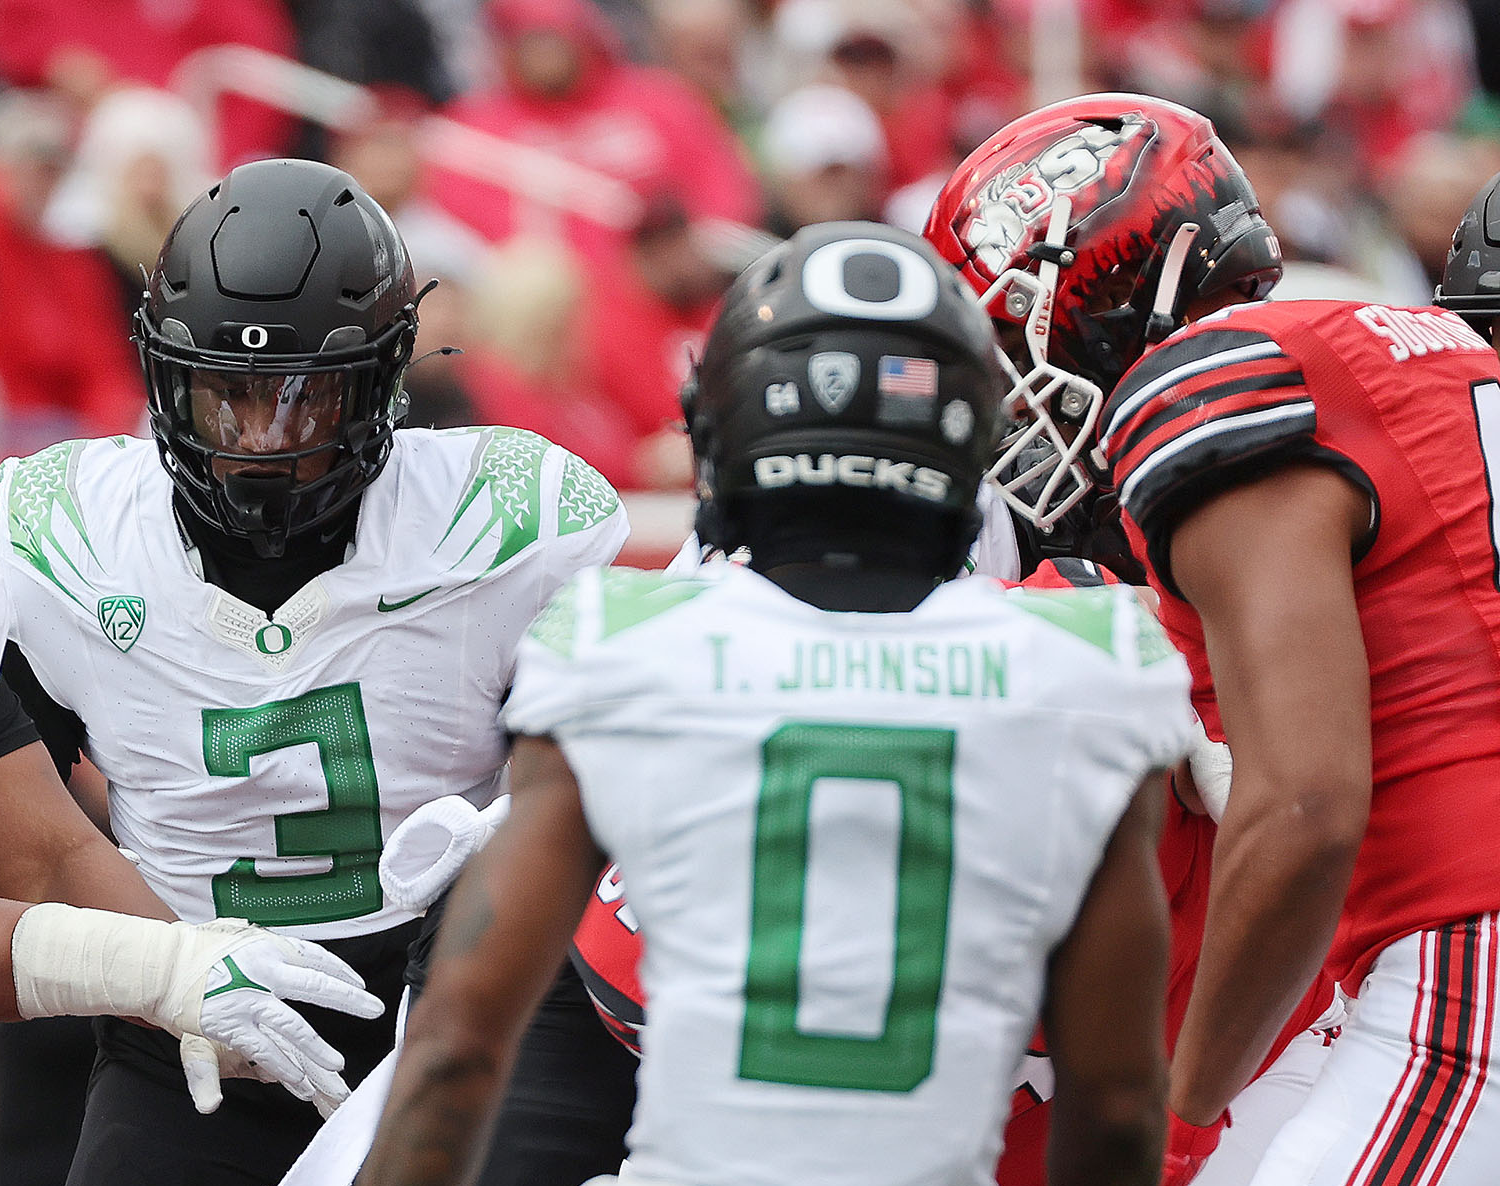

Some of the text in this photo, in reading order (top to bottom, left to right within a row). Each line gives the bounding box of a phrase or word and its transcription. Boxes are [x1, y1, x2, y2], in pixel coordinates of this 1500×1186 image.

[802, 238, 939, 321] O
[241, 325, 268, 348] O
[753, 454, 951, 501] DUCKS
[101, 599, 142, 629] PAC
[112, 621, 133, 641] 12
[255, 624, 293, 654] O
[706, 635, 1010, 698] T. JOHNSON
[201, 681, 384, 927] 3
